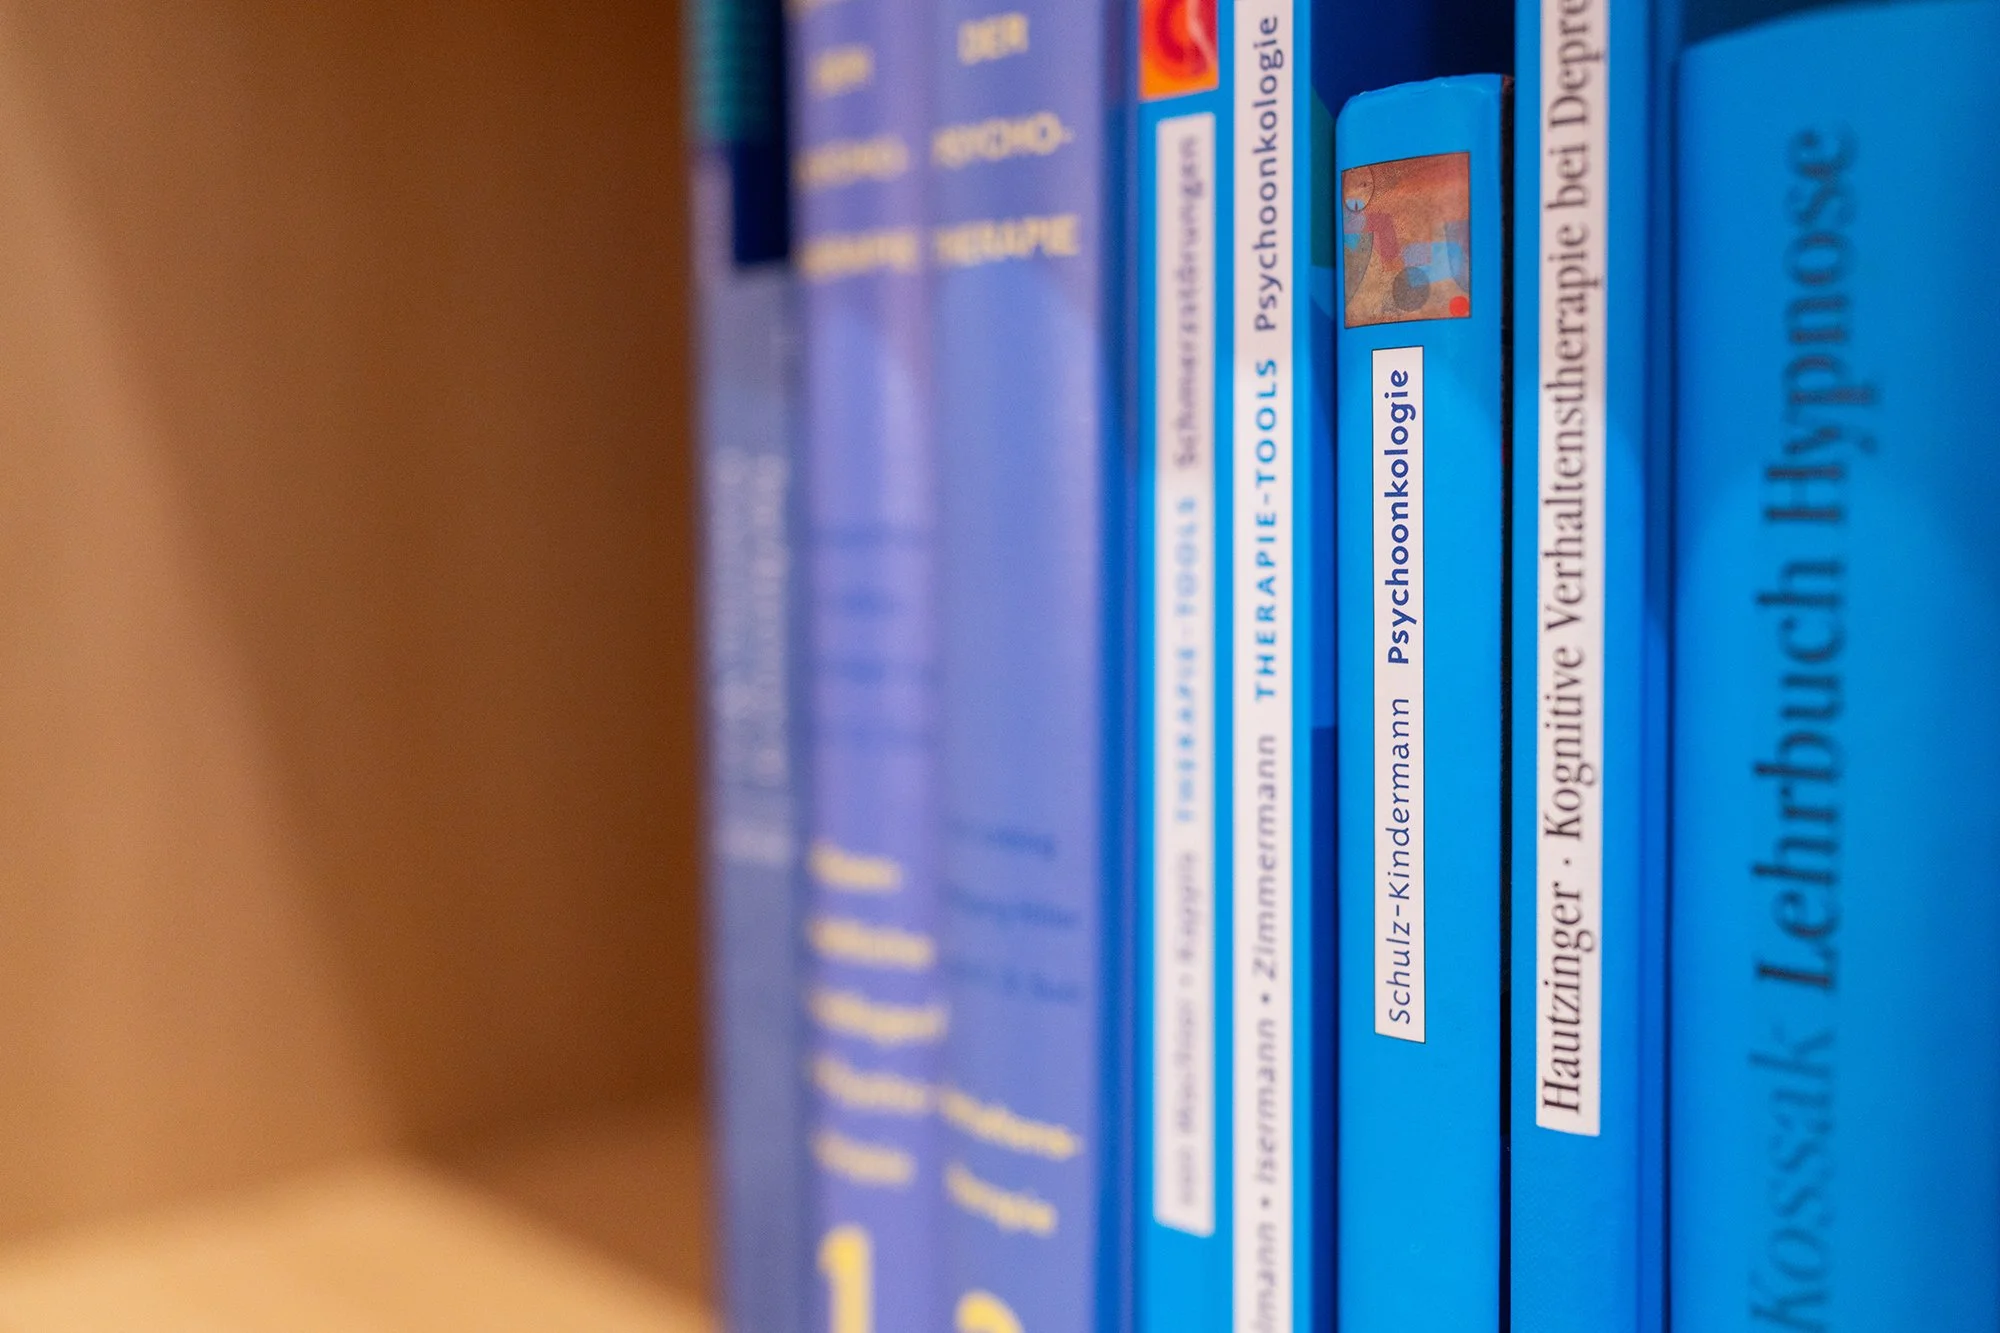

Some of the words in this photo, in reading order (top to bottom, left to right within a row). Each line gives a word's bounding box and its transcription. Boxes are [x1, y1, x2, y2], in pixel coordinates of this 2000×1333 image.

[1252, 15, 1284, 333] Psychoonkologie
[1546, 142, 1587, 211] bei
[1761, 128, 1880, 524] Hypnose
[1255, 357, 1278, 703] THERAPIE-TOOLS
[1383, 368, 1418, 666] Psychoonkologie
[1543, 224, 1602, 634] Verhaltenstherapie
[1252, 733, 1279, 982] Zimmermann
[1384, 697, 1412, 1025] Schulz-Kindermann
[1544, 646, 1600, 842] Kognitive
[1751, 557, 1848, 996] Lehrbuch
[1542, 880, 1597, 1115] Hautzinger
